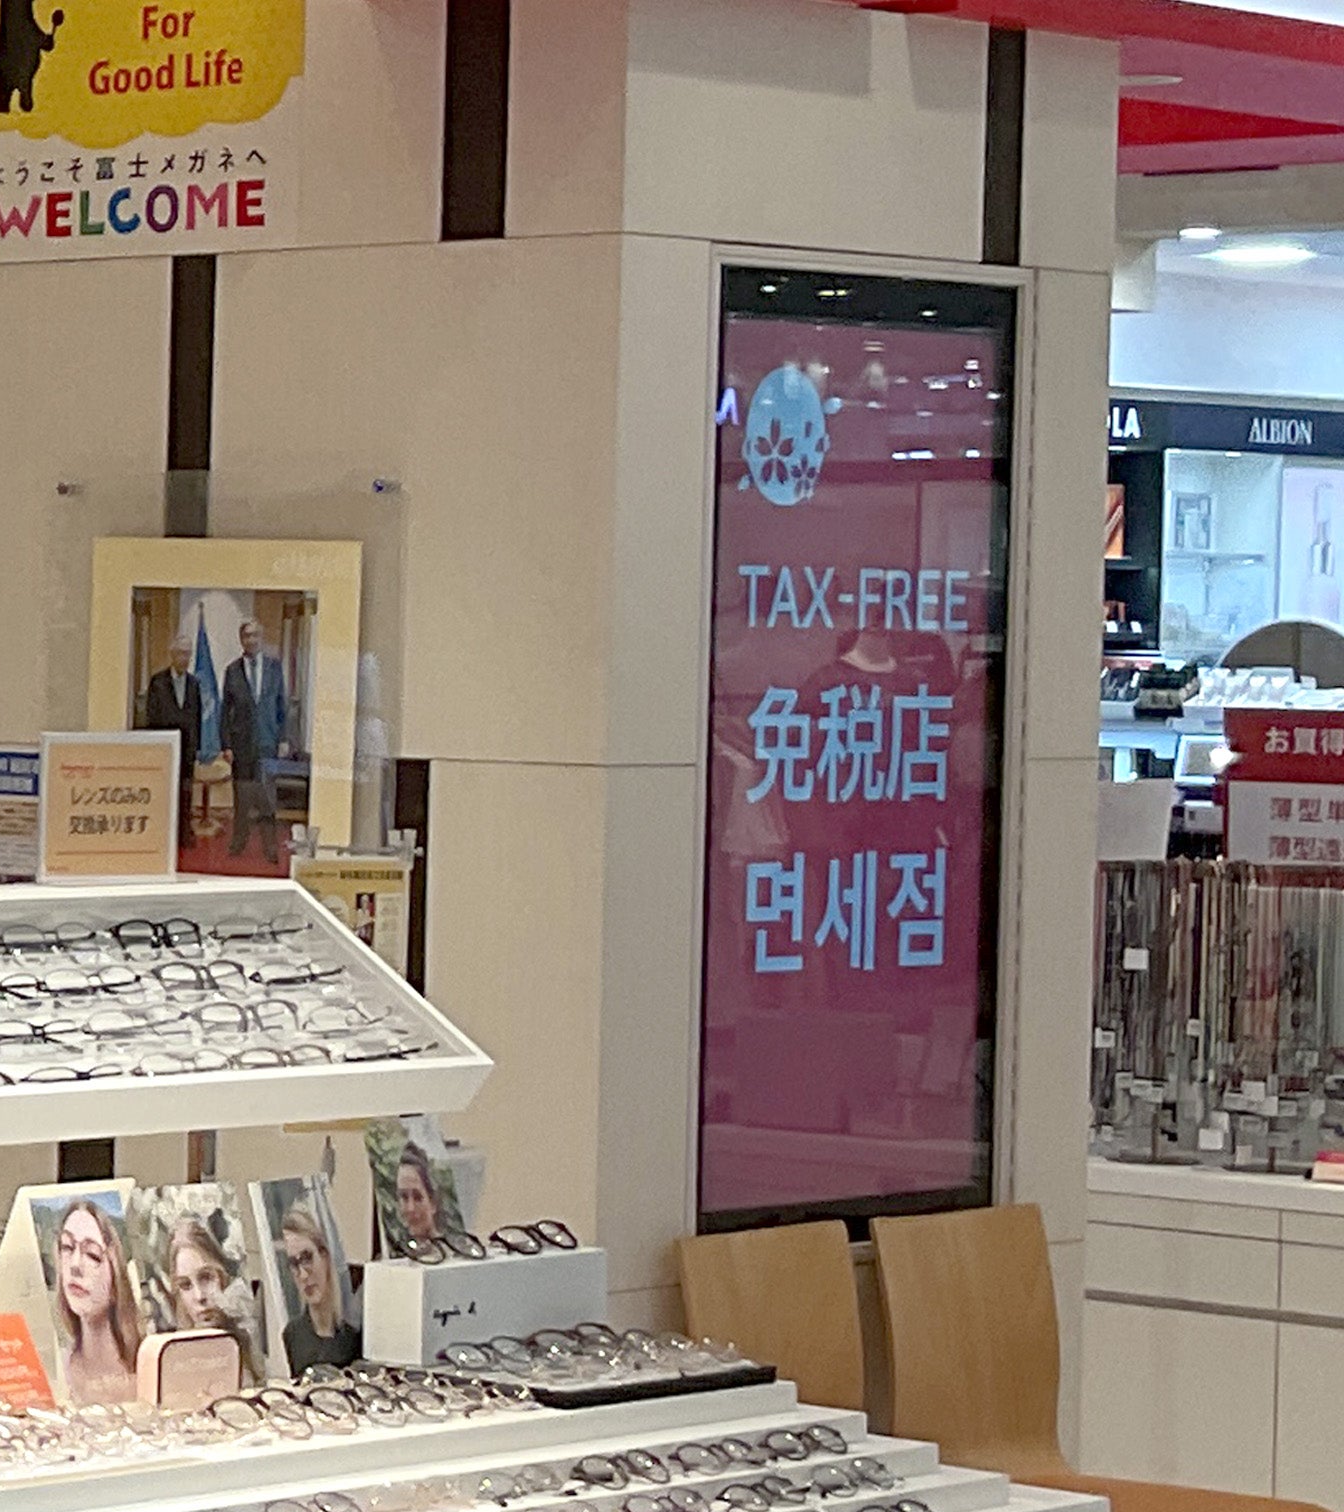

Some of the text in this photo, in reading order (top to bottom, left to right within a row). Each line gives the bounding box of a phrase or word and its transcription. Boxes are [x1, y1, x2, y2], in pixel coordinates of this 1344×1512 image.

[141, 5, 195, 41] For
[88, 48, 244, 96] Good Life
[1106, 406, 1142, 440] LA
[1247, 416, 1313, 446] ALBION
[738, 564, 971, 633] TAX-FREE
[745, 683, 955, 804] 免税店
[745, 847, 947, 973] 면세점
